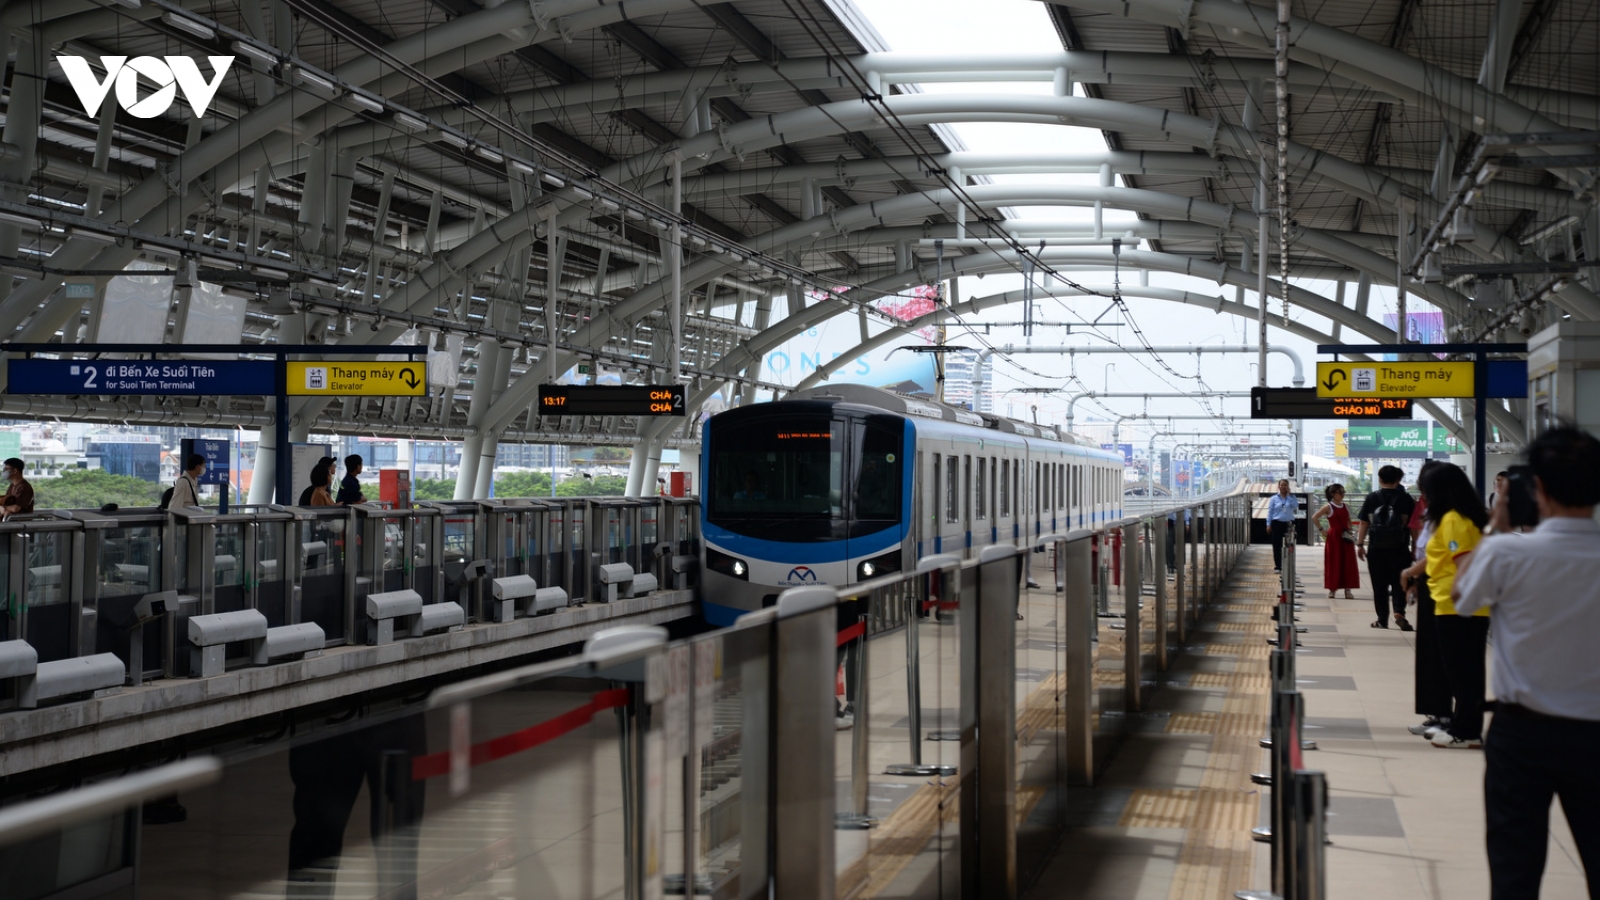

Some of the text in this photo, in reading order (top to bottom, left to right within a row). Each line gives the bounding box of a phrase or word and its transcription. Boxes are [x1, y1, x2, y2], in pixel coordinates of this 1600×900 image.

[105, 364, 215, 377] đi Bến Xe Suối Tiên
[331, 367, 395, 380] Thang máy
[1380, 368, 1452, 381] Thang máy
[83, 366, 97, 388] 2
[105, 381, 195, 389] for Suoi Tien Terminal
[331, 382, 364, 390] Elevator
[1380, 384, 1417, 392] Elevator
[650, 390, 671, 400] CHÀ
[543, 397, 566, 406] 13:17
[674, 394, 682, 408] 2
[1255, 396, 1262, 411] 1
[1382, 399, 1408, 409] 13:17
[650, 402, 671, 412] CHÀ
[1333, 404, 1363, 415] CHÀO
